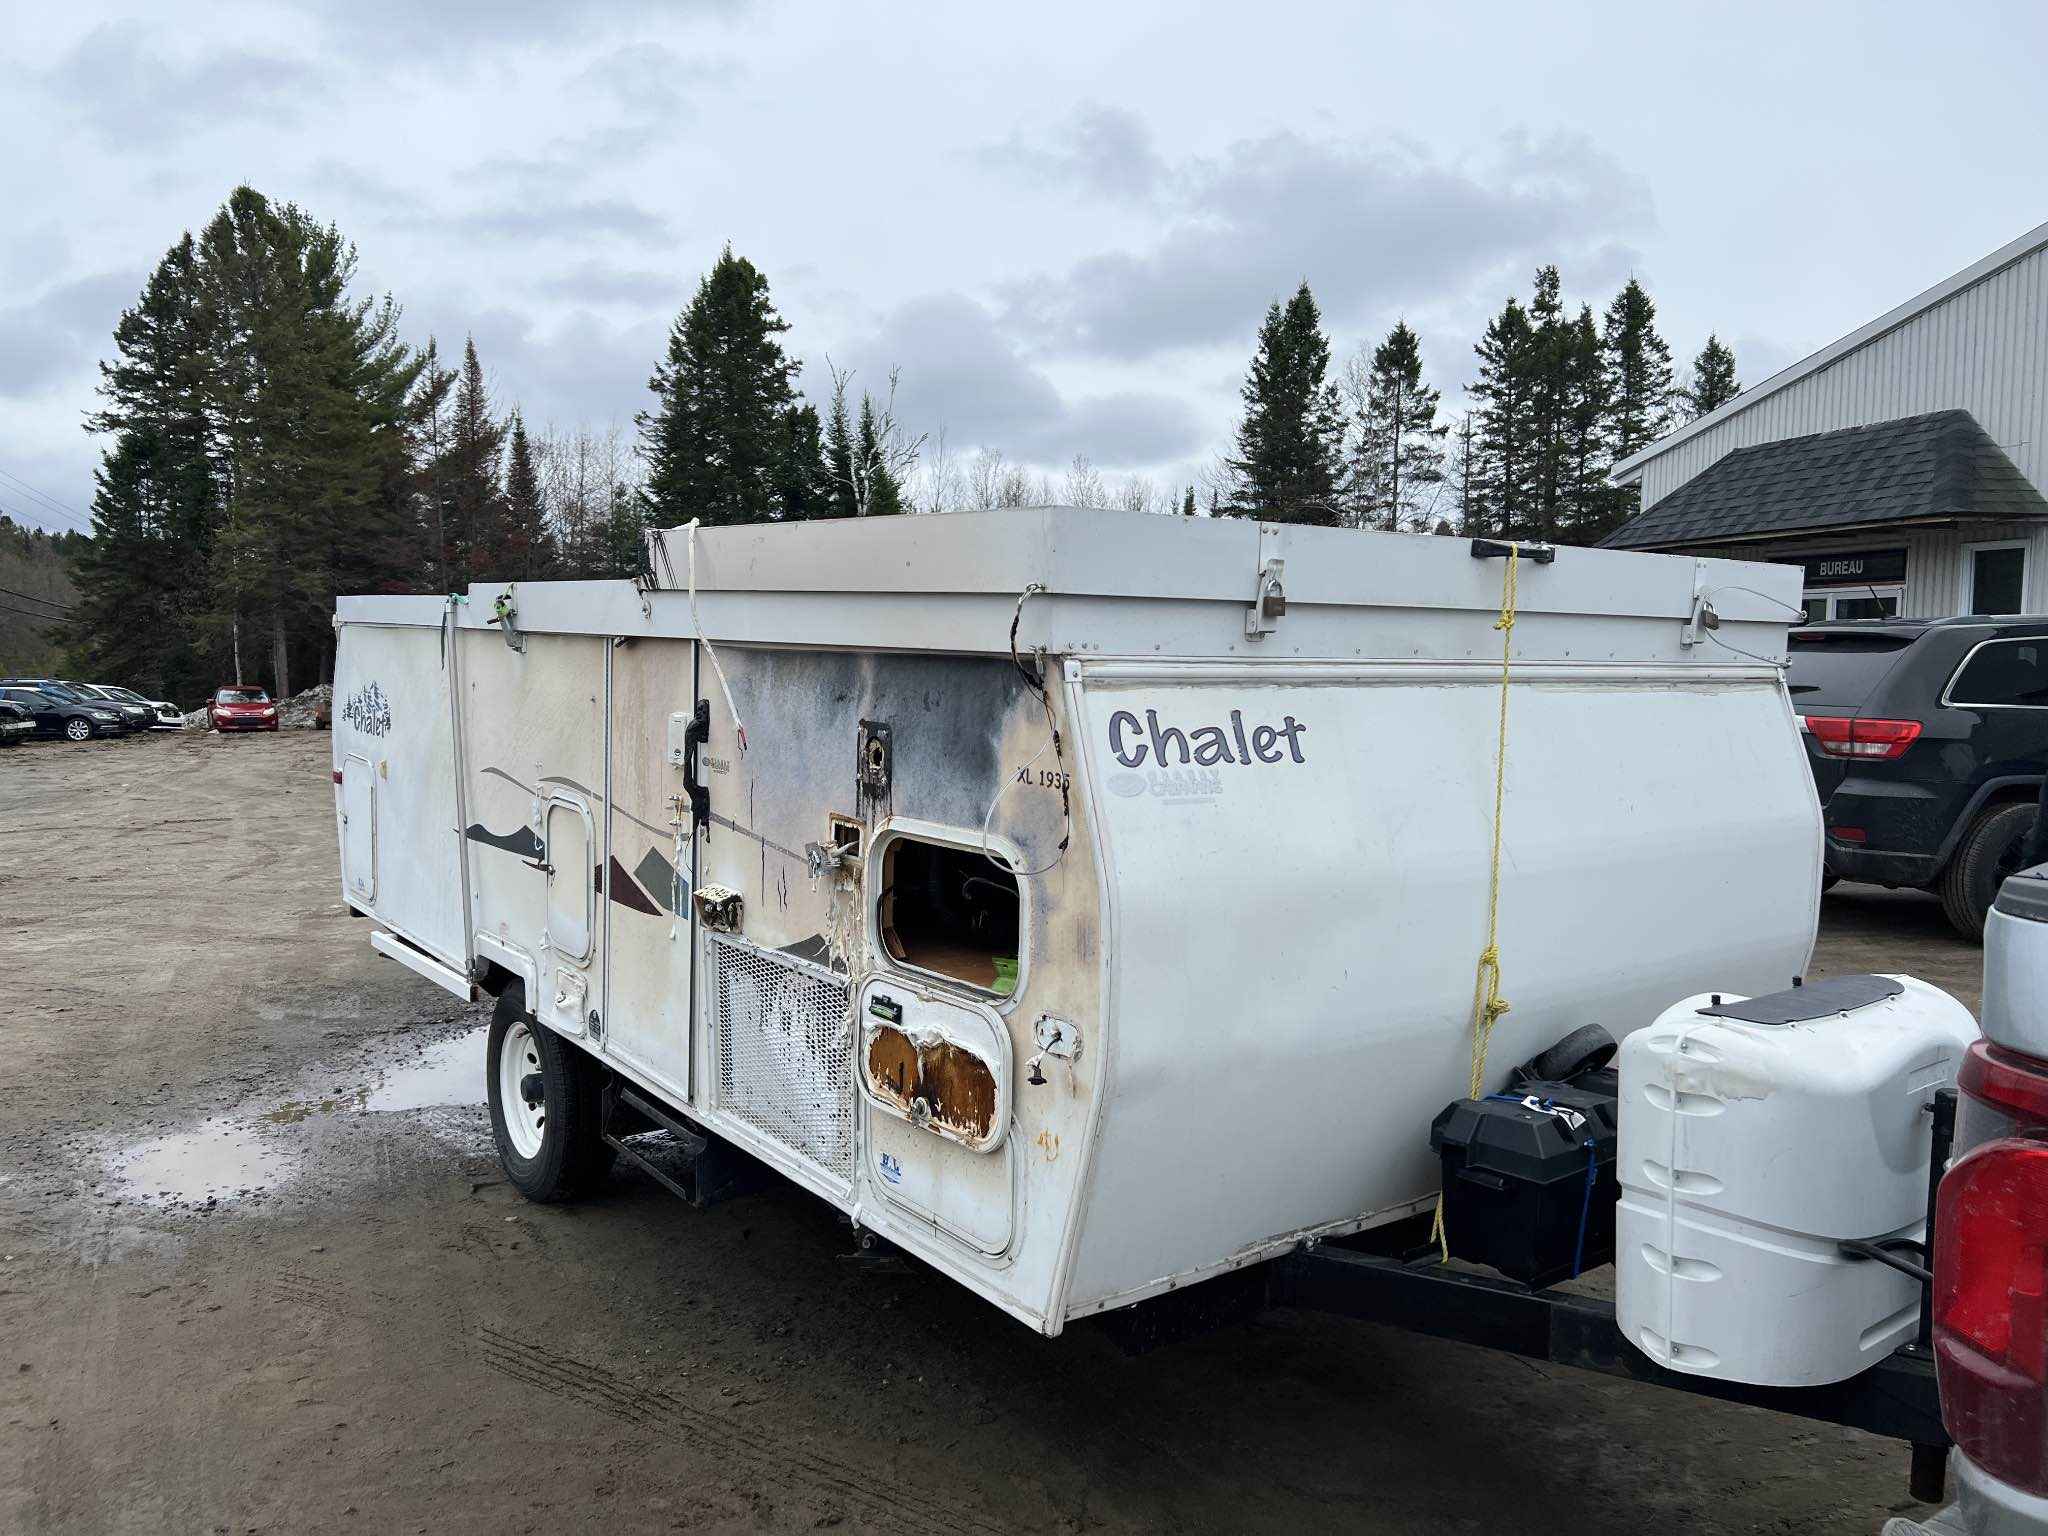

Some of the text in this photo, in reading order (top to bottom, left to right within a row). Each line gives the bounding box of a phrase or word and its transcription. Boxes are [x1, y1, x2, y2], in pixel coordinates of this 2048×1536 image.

[1819, 559, 1864, 576] BUREAU
[353, 704, 387, 738] Chalet
[1108, 709, 1306, 768] Chalet
[1017, 766, 1033, 785] XL
